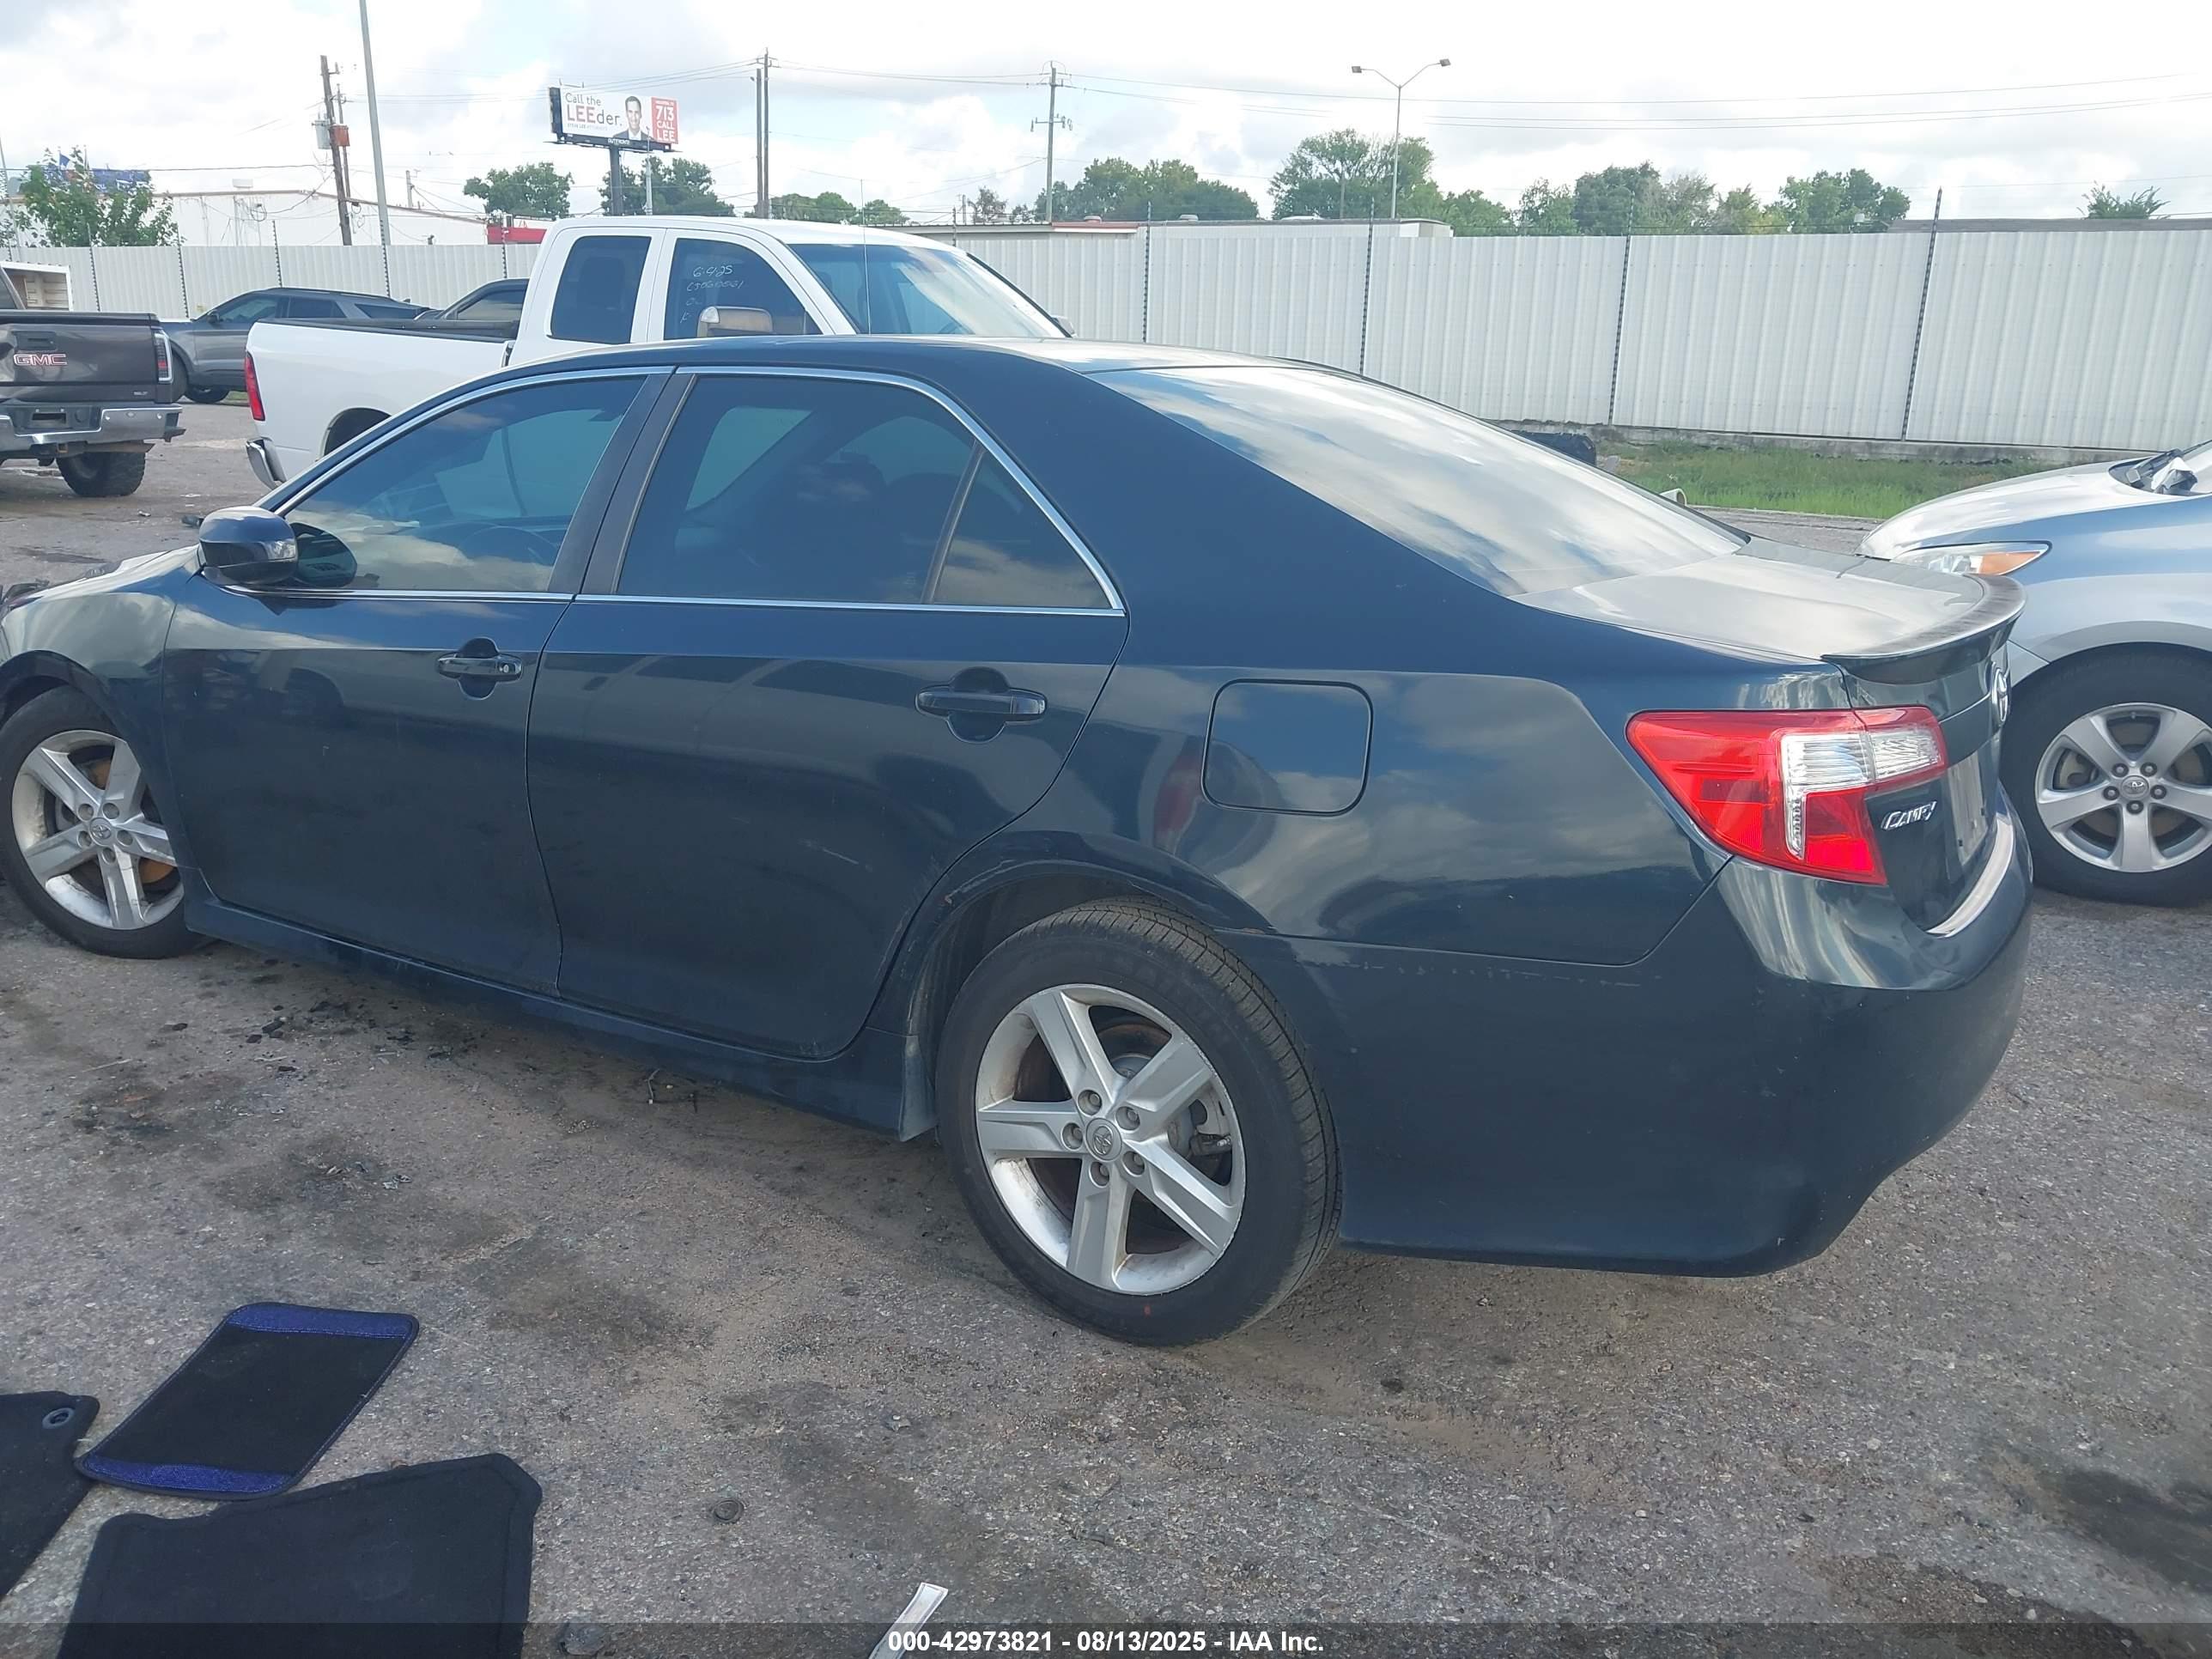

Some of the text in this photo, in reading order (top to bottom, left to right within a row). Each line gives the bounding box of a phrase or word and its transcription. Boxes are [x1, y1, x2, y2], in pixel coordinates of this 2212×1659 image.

[565, 92, 601, 106] Call the
[566, 104, 623, 127] LEEder.
[655, 105, 675, 121] 713
[656, 120, 676, 131] CALL
[656, 129, 677, 143] LEE
[14, 353, 68, 367] GMC
